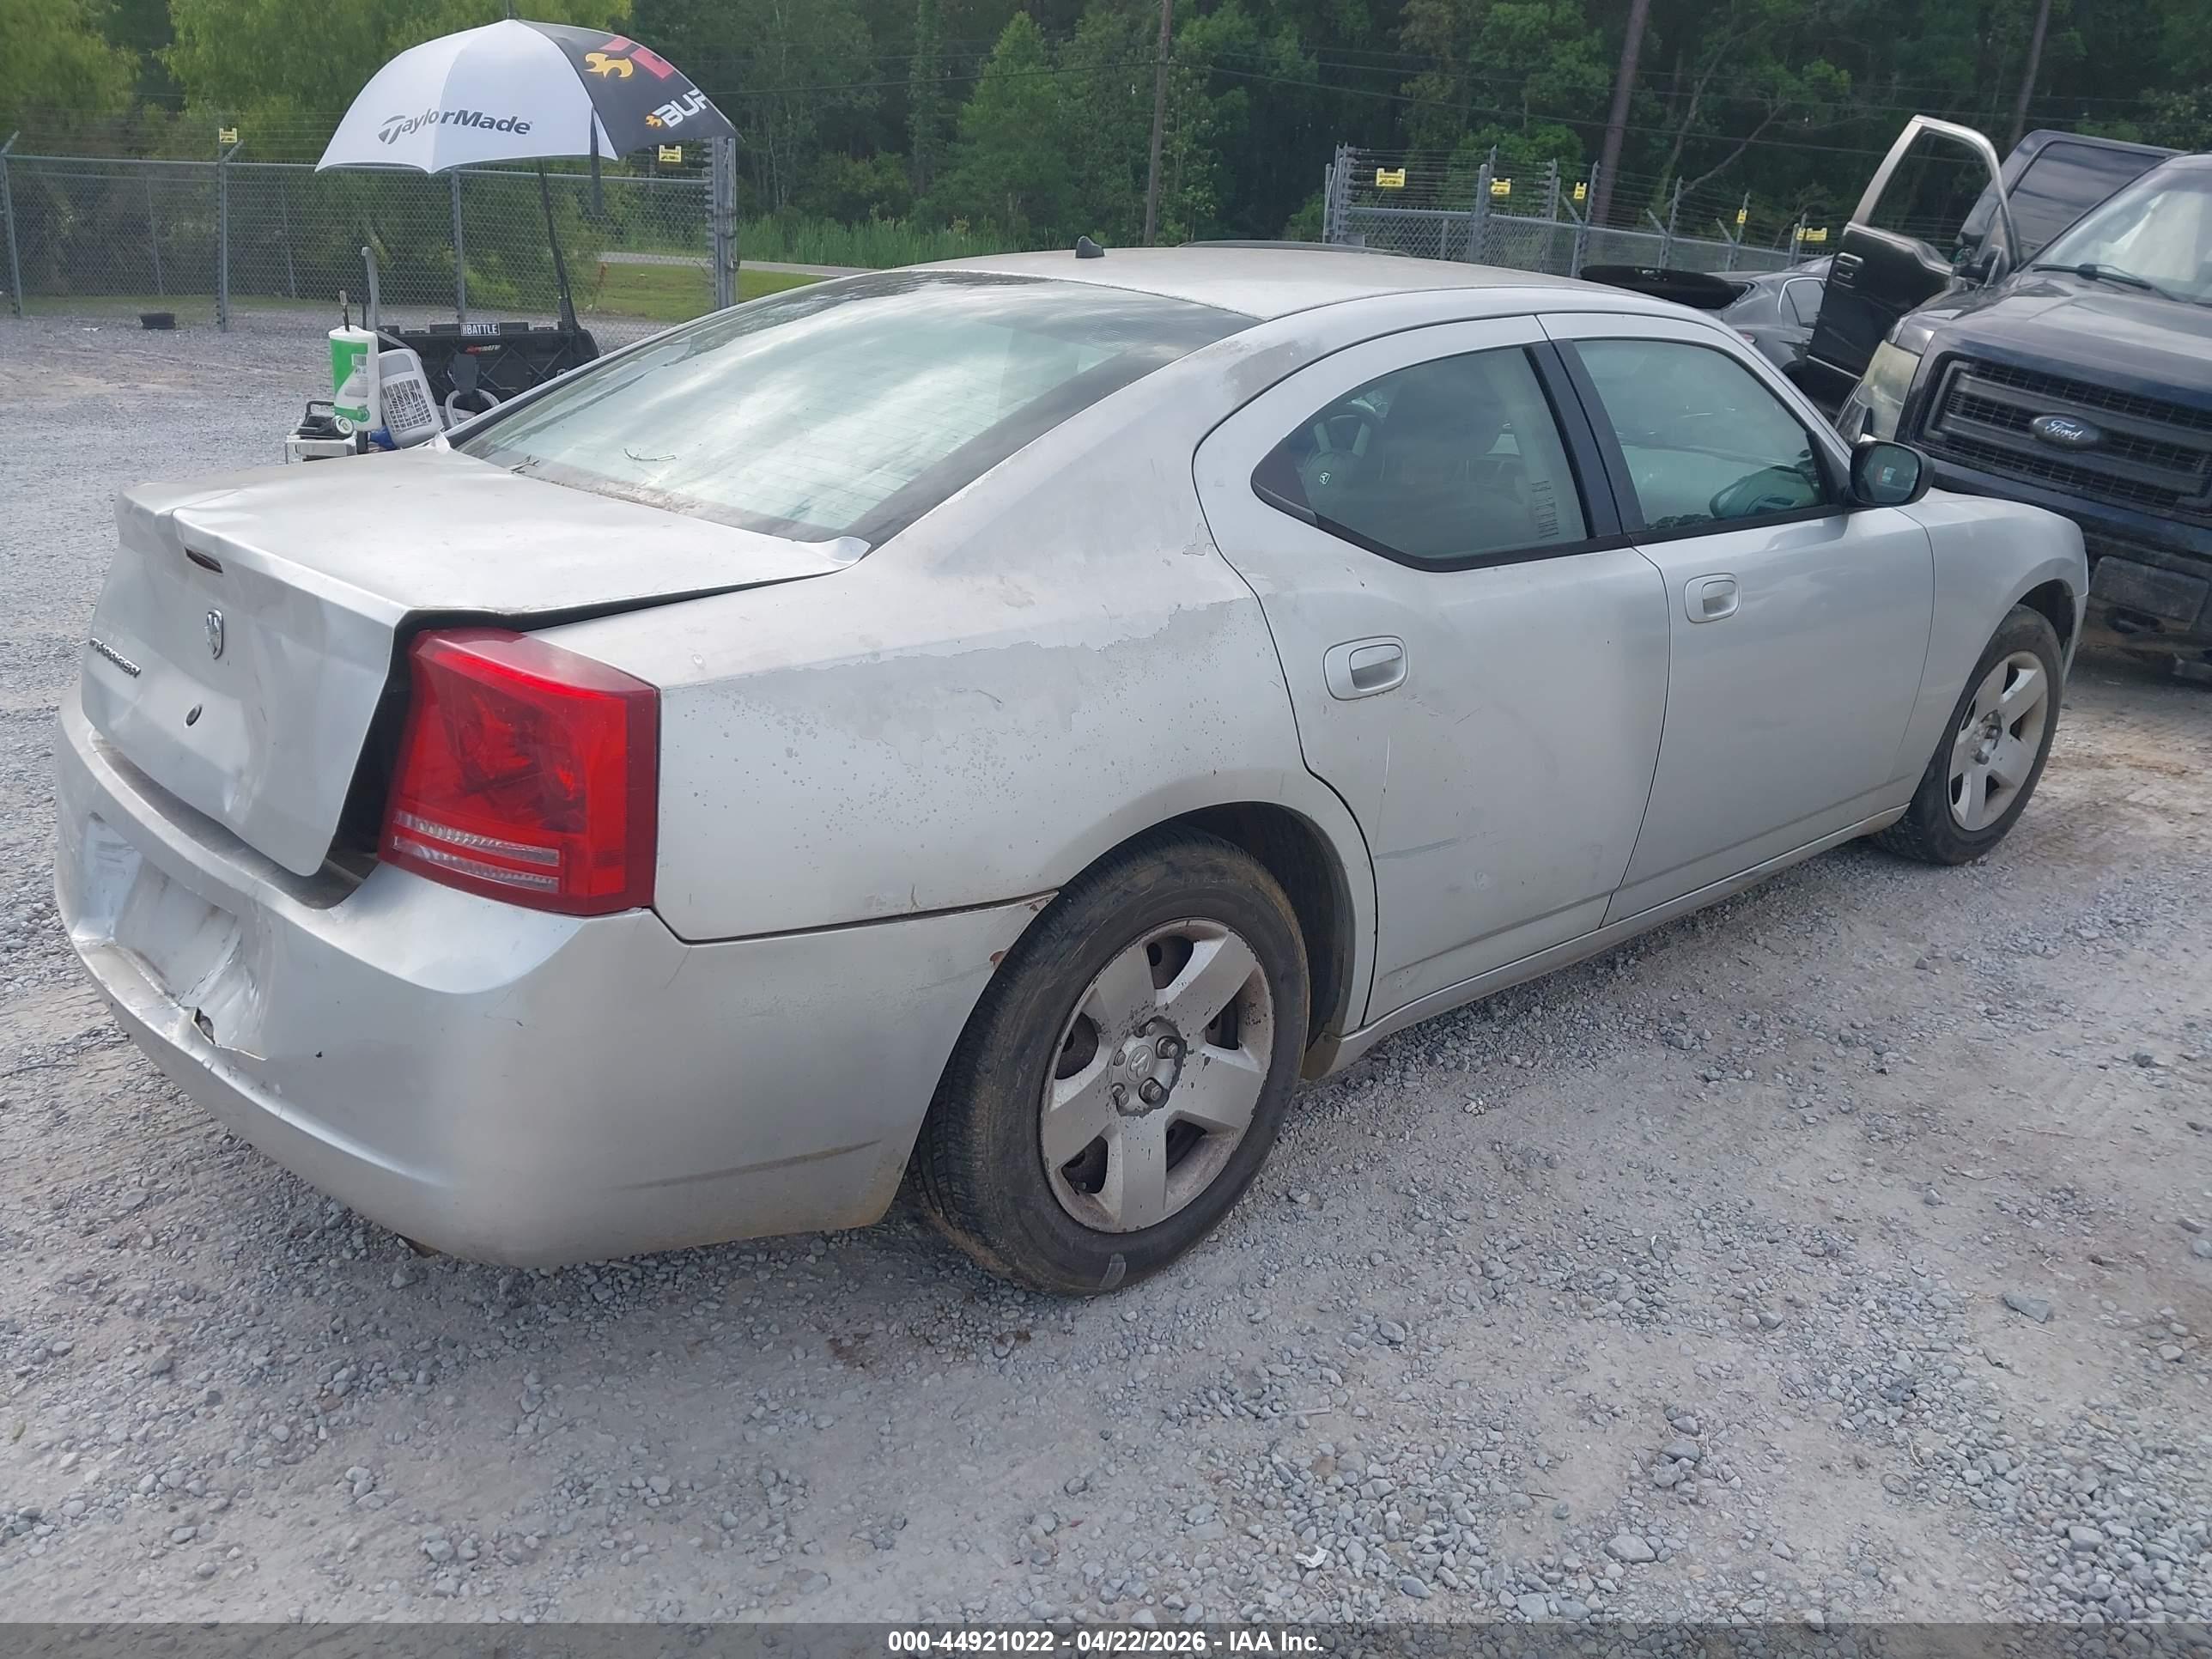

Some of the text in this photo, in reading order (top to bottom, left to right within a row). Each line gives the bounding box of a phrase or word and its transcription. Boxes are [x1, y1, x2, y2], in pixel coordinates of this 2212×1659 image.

[378, 108, 532, 144] TaylorMade
[466, 324, 498, 335] BATTLE
[2045, 420, 2084, 441] Ford
